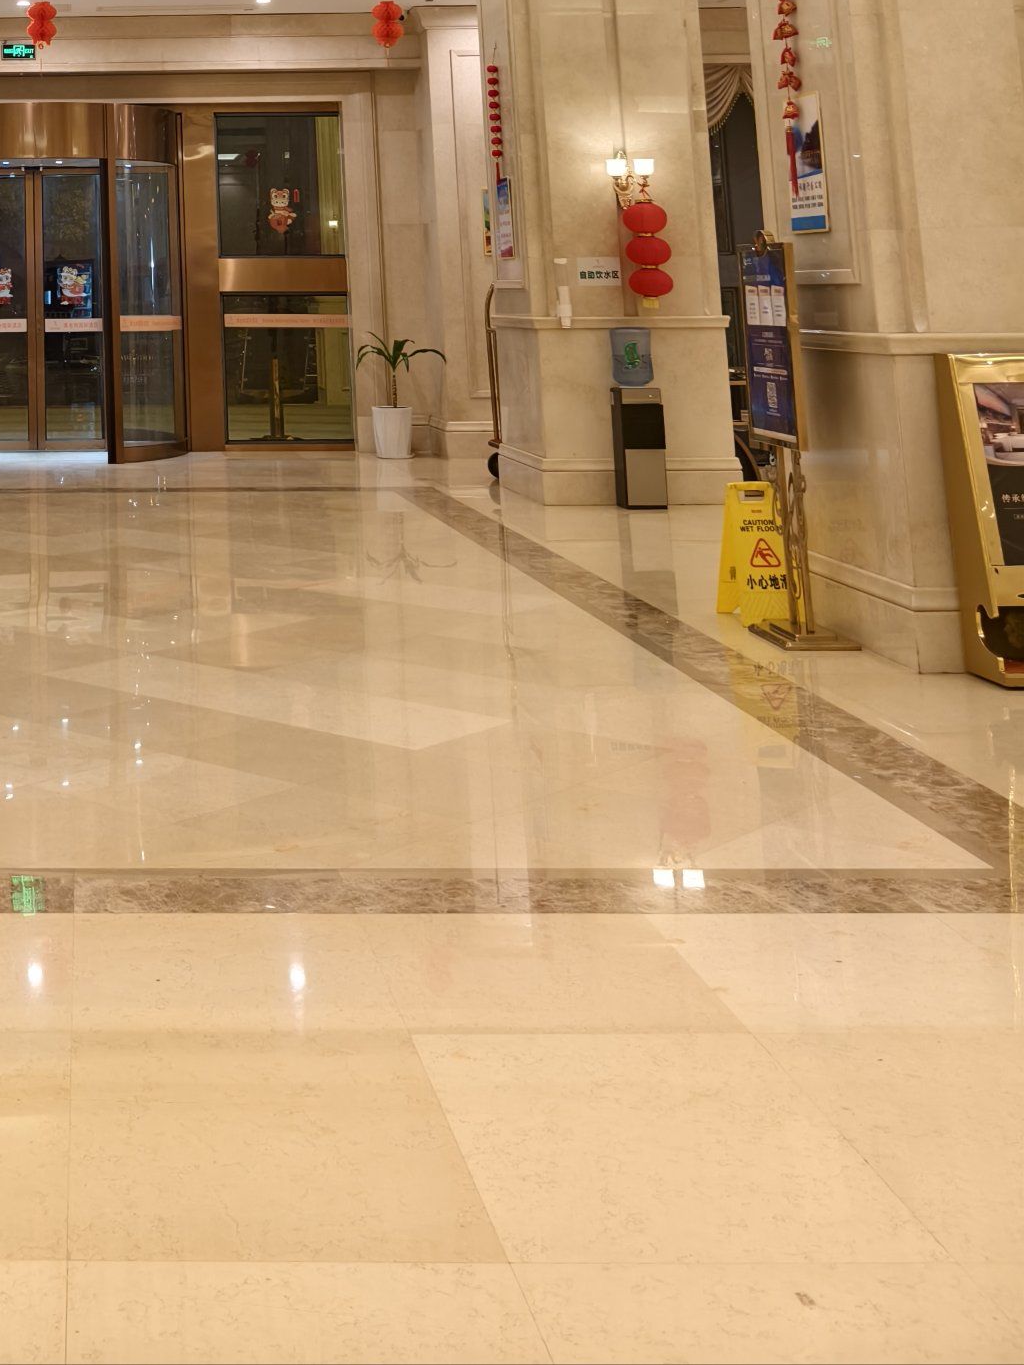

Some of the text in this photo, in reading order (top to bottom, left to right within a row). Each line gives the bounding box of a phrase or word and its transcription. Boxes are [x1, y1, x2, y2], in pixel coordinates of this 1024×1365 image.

[579, 271, 619, 279] 自动饮水区
